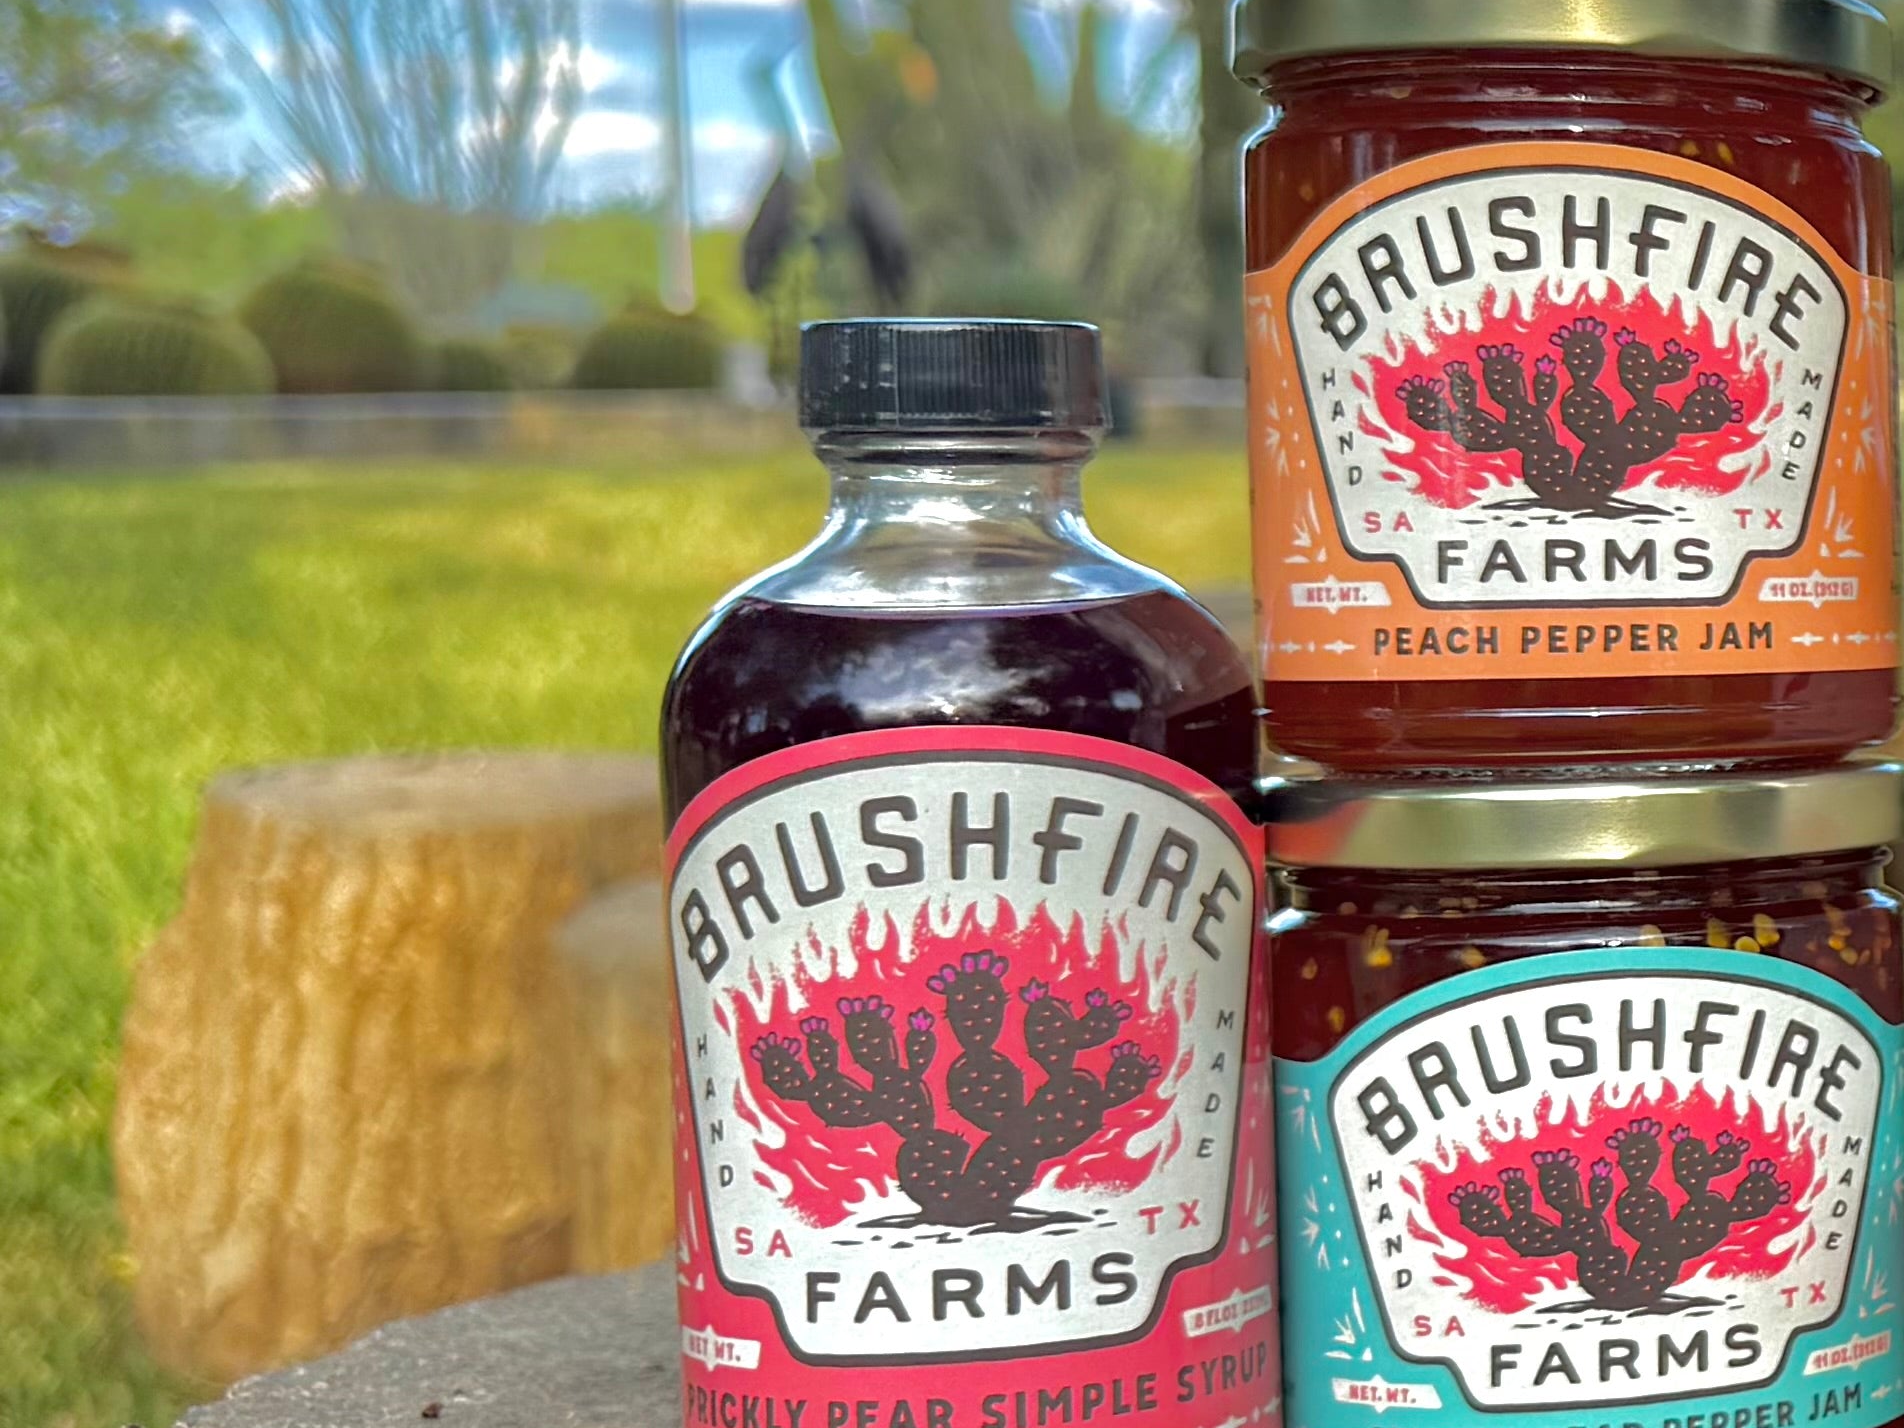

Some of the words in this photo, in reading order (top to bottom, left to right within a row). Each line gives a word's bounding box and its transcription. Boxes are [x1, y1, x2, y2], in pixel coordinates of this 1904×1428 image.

[1313, 195, 1822, 351] BRUSHFIRE
[1323, 369, 1362, 486] HAND
[1781, 368, 1823, 481] MADE
[1364, 510, 1414, 533] SA
[1735, 508, 1783, 530] TX
[1438, 537, 1713, 582] FARMS
[1373, 624, 1500, 655] PEACH
[1521, 623, 1678, 654] PEPPER
[1699, 620, 1773, 650] JAM
[681, 791, 1243, 984] BRUSHFIRE
[1198, 1009, 1235, 1159] MADE
[1357, 998, 1860, 1155] BRUSHFIRE
[696, 1035, 733, 1189] HAND
[1139, 1199, 1200, 1235] TX
[1825, 1136, 1860, 1250] MADE
[736, 1226, 791, 1258] SA
[1367, 1171, 1413, 1288] HAND
[806, 1254, 1137, 1324] FARMS
[1780, 1280, 1826, 1308] TX
[1414, 1315, 1465, 1338] SA
[1490, 1324, 1761, 1387] FARMS
[1177, 1341, 1267, 1403] SYRUP
[1809, 1384, 1861, 1421] JAM
